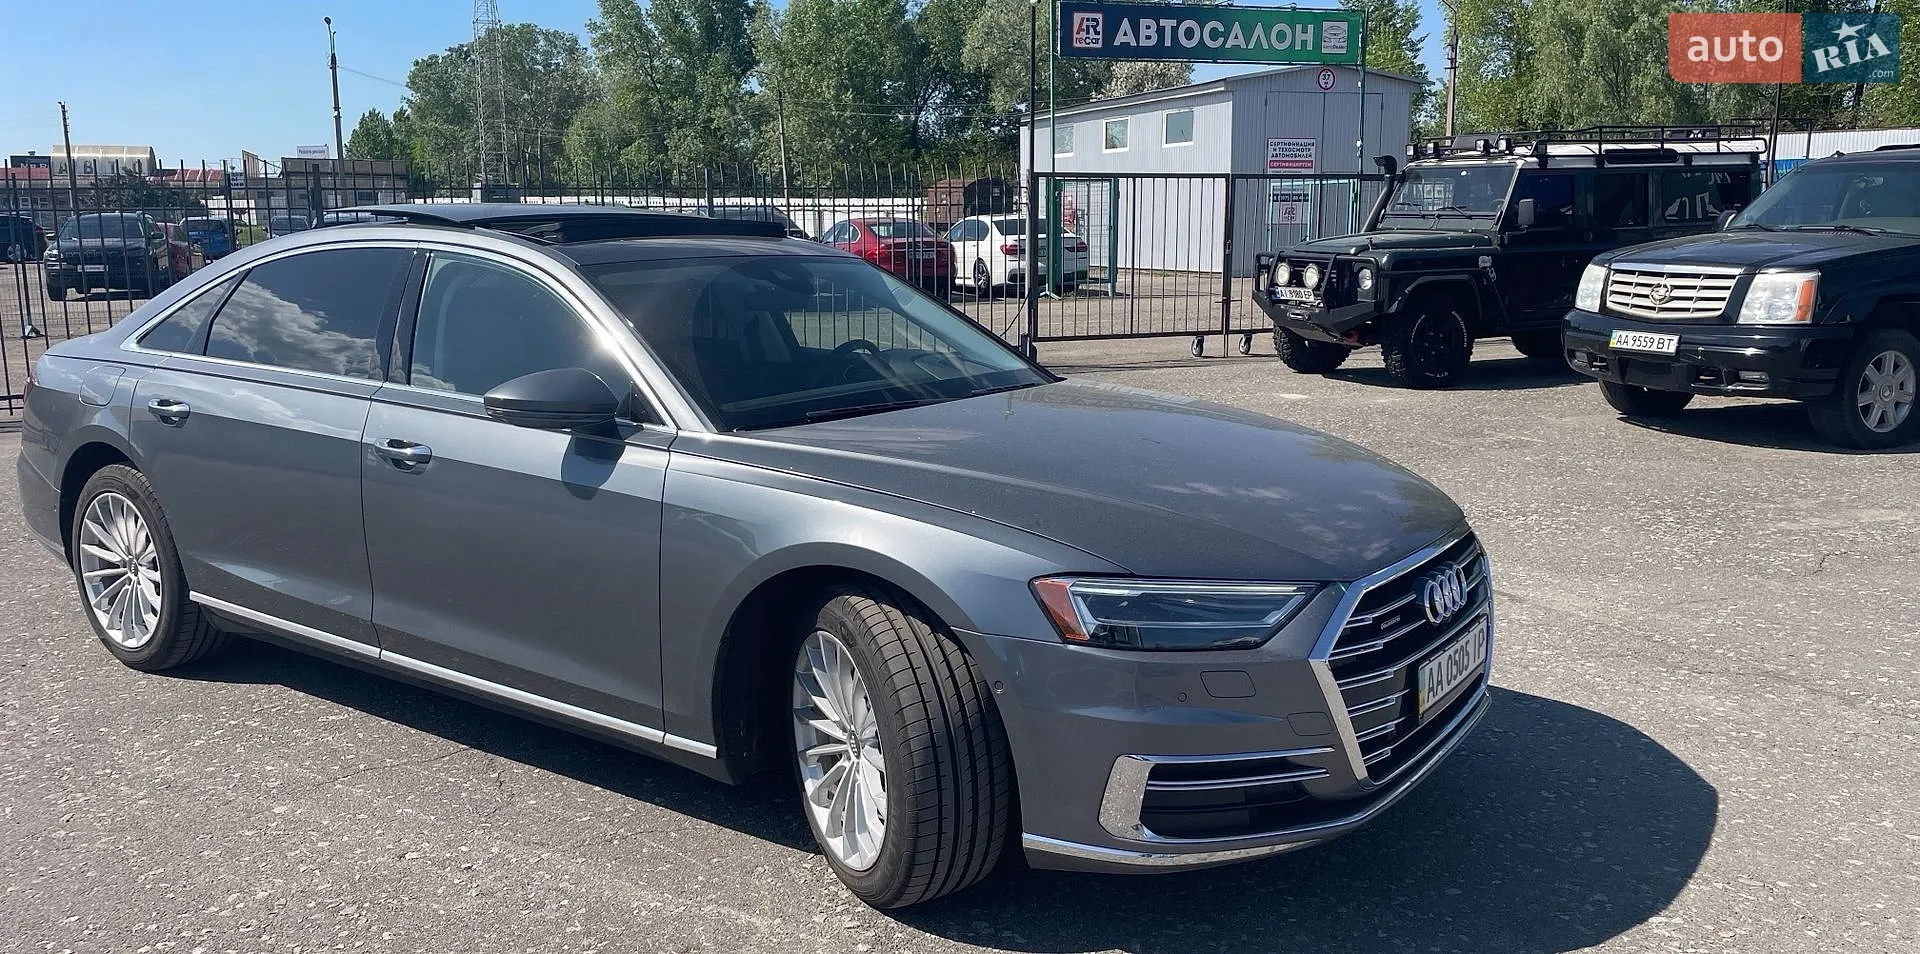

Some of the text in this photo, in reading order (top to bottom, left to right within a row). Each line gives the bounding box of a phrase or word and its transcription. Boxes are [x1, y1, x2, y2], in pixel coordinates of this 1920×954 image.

[1113, 17, 1314, 51] АВТОСАЛОН
[1616, 334, 1674, 351] AA 9559 BT
[1426, 629, 1485, 704] AA 0505 IP
